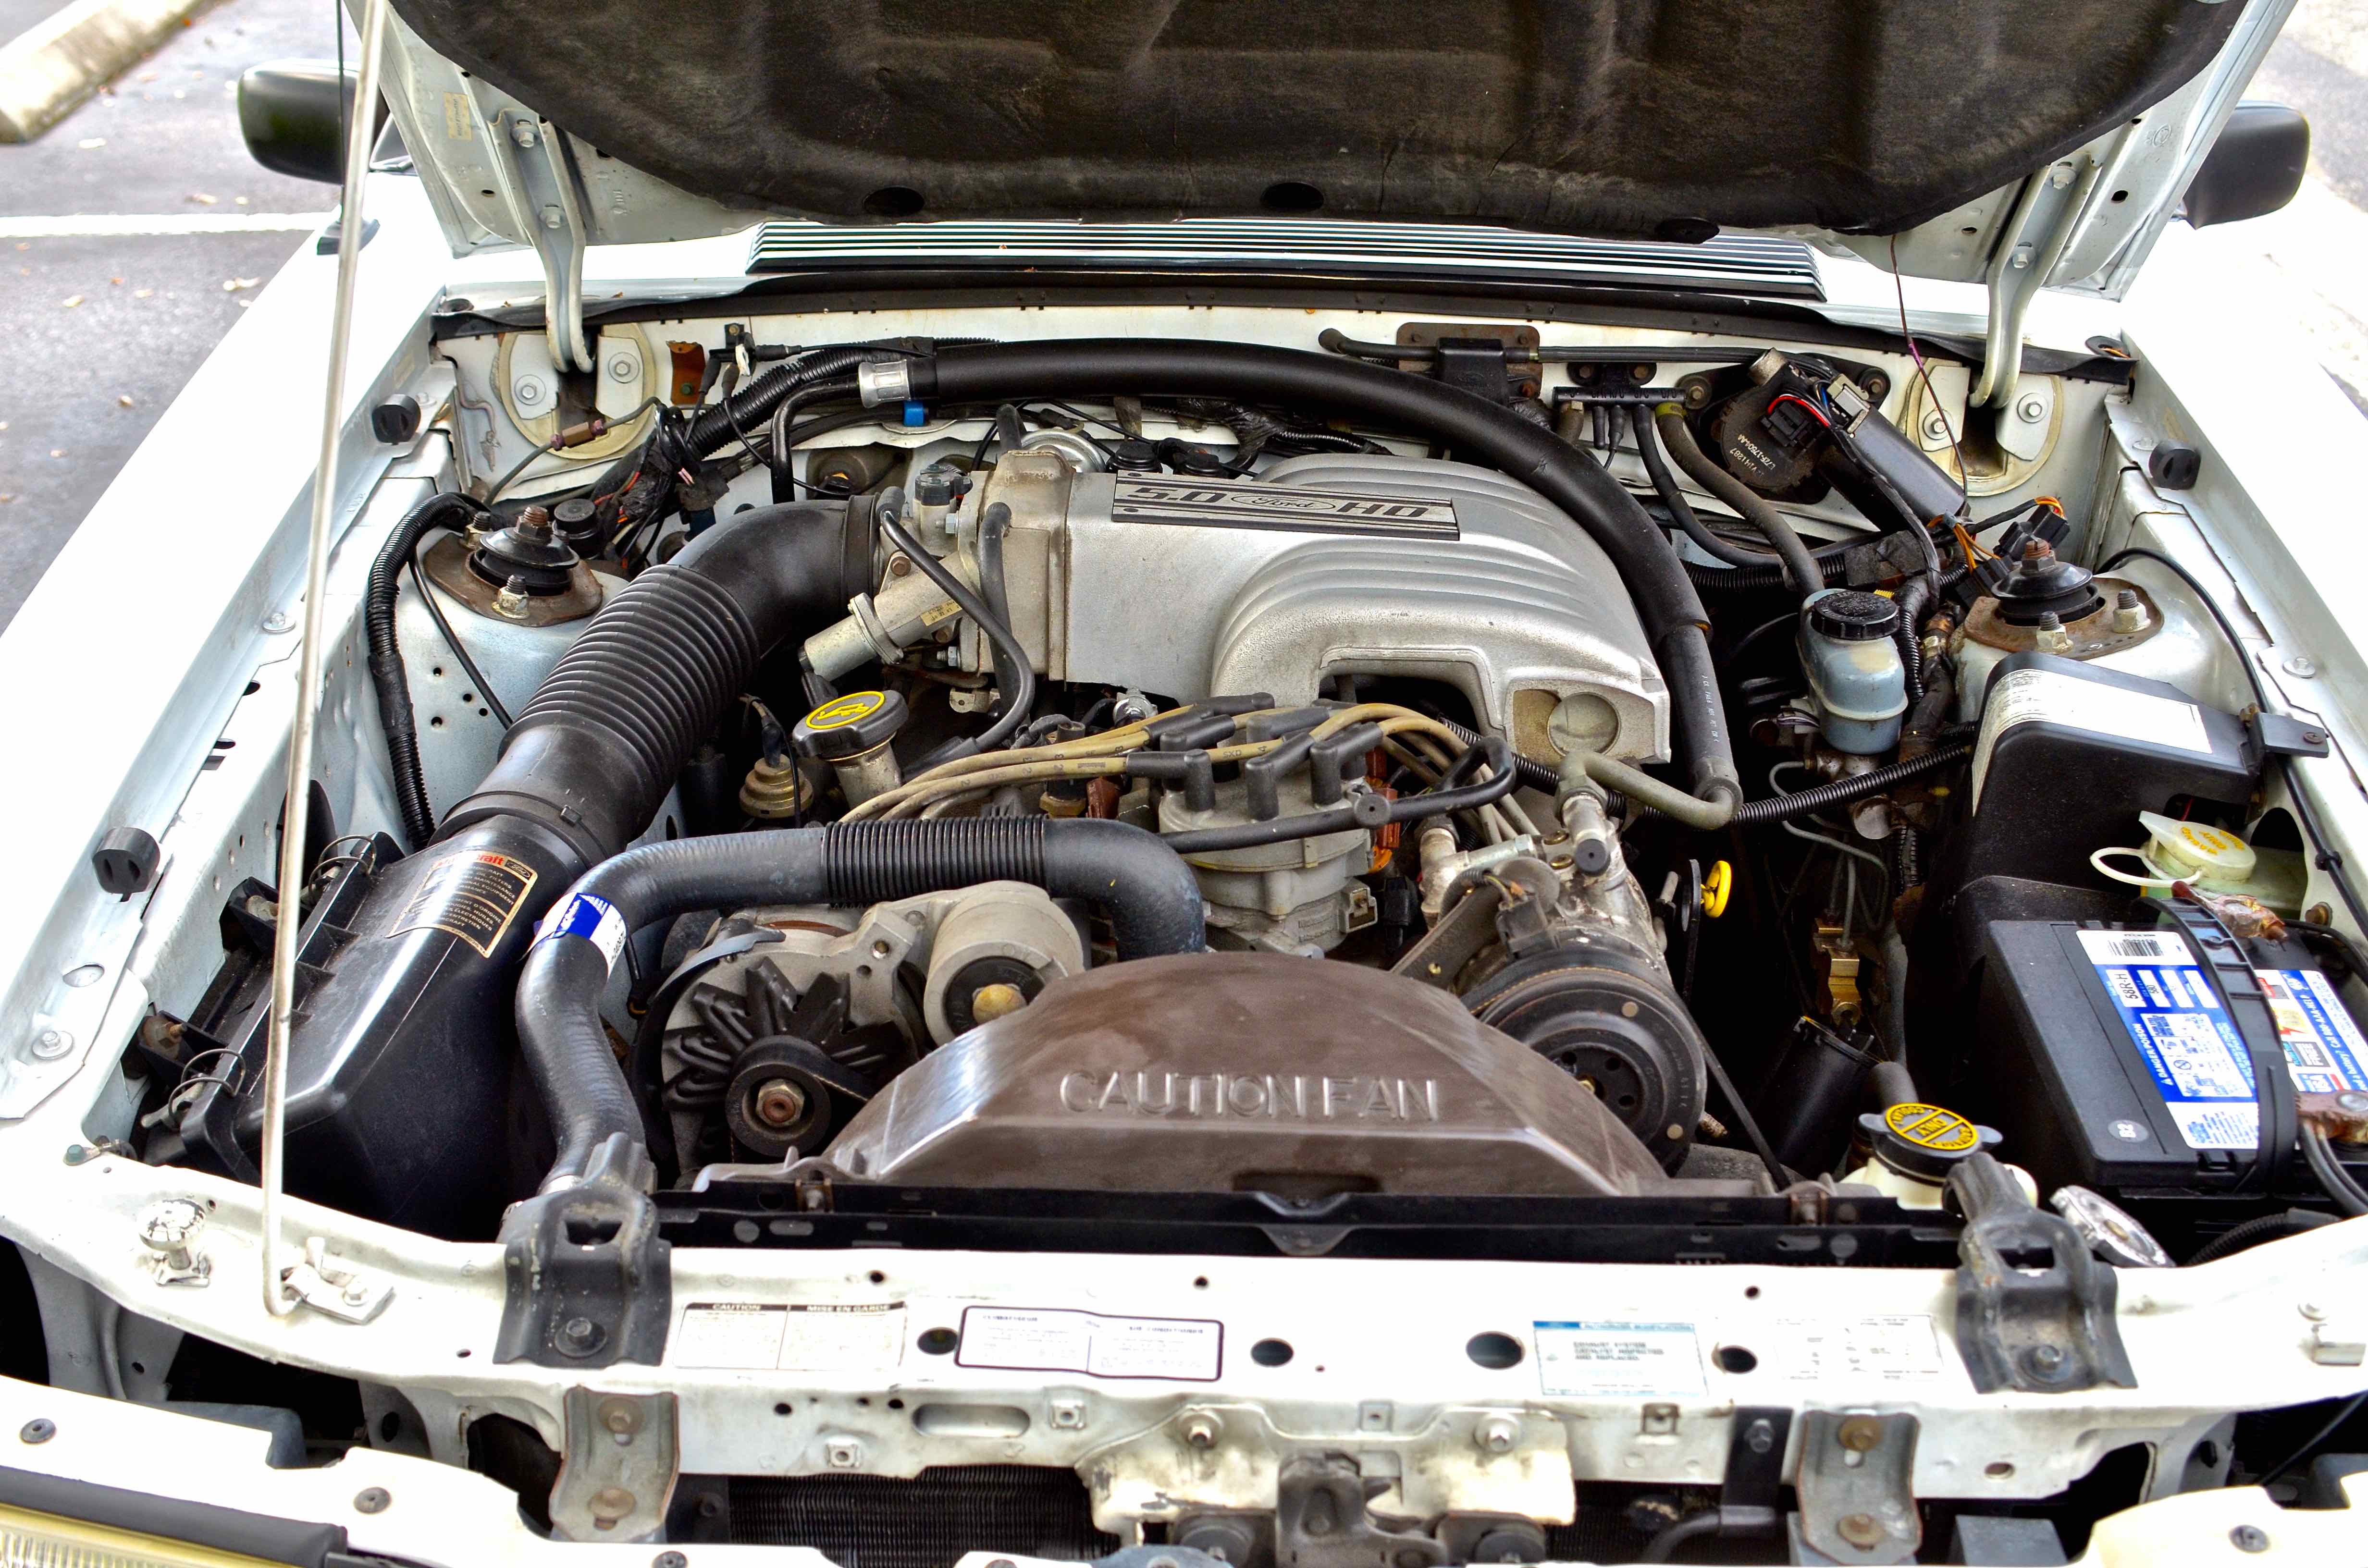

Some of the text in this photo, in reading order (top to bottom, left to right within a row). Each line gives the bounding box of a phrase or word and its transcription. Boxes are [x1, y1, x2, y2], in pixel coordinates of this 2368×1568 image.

[1127, 487, 1228, 503] 5.0
[1250, 496, 1315, 509] Ford
[2114, 973, 2139, 999] 58R-H
[1060, 1071, 1438, 1122] CAUTION FAN
[1916, 1117, 1947, 1136] ONLY
